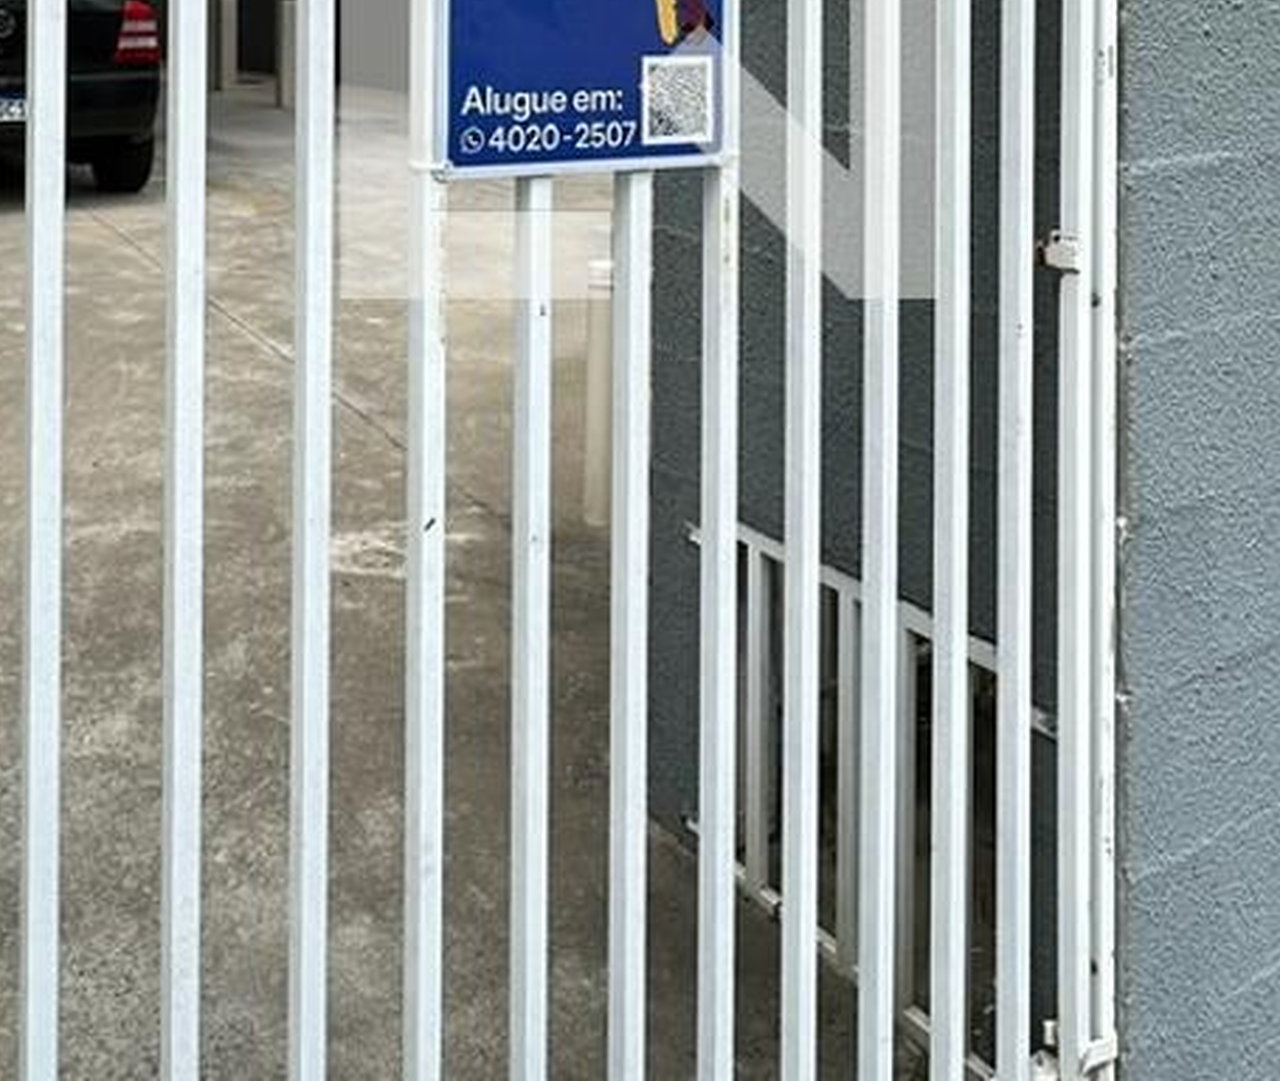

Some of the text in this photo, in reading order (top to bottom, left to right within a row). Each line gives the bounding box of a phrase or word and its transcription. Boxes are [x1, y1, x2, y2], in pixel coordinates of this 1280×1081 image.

[460, 85, 623, 122] Alugue em:
[488, 120, 637, 153] 4020-2507
